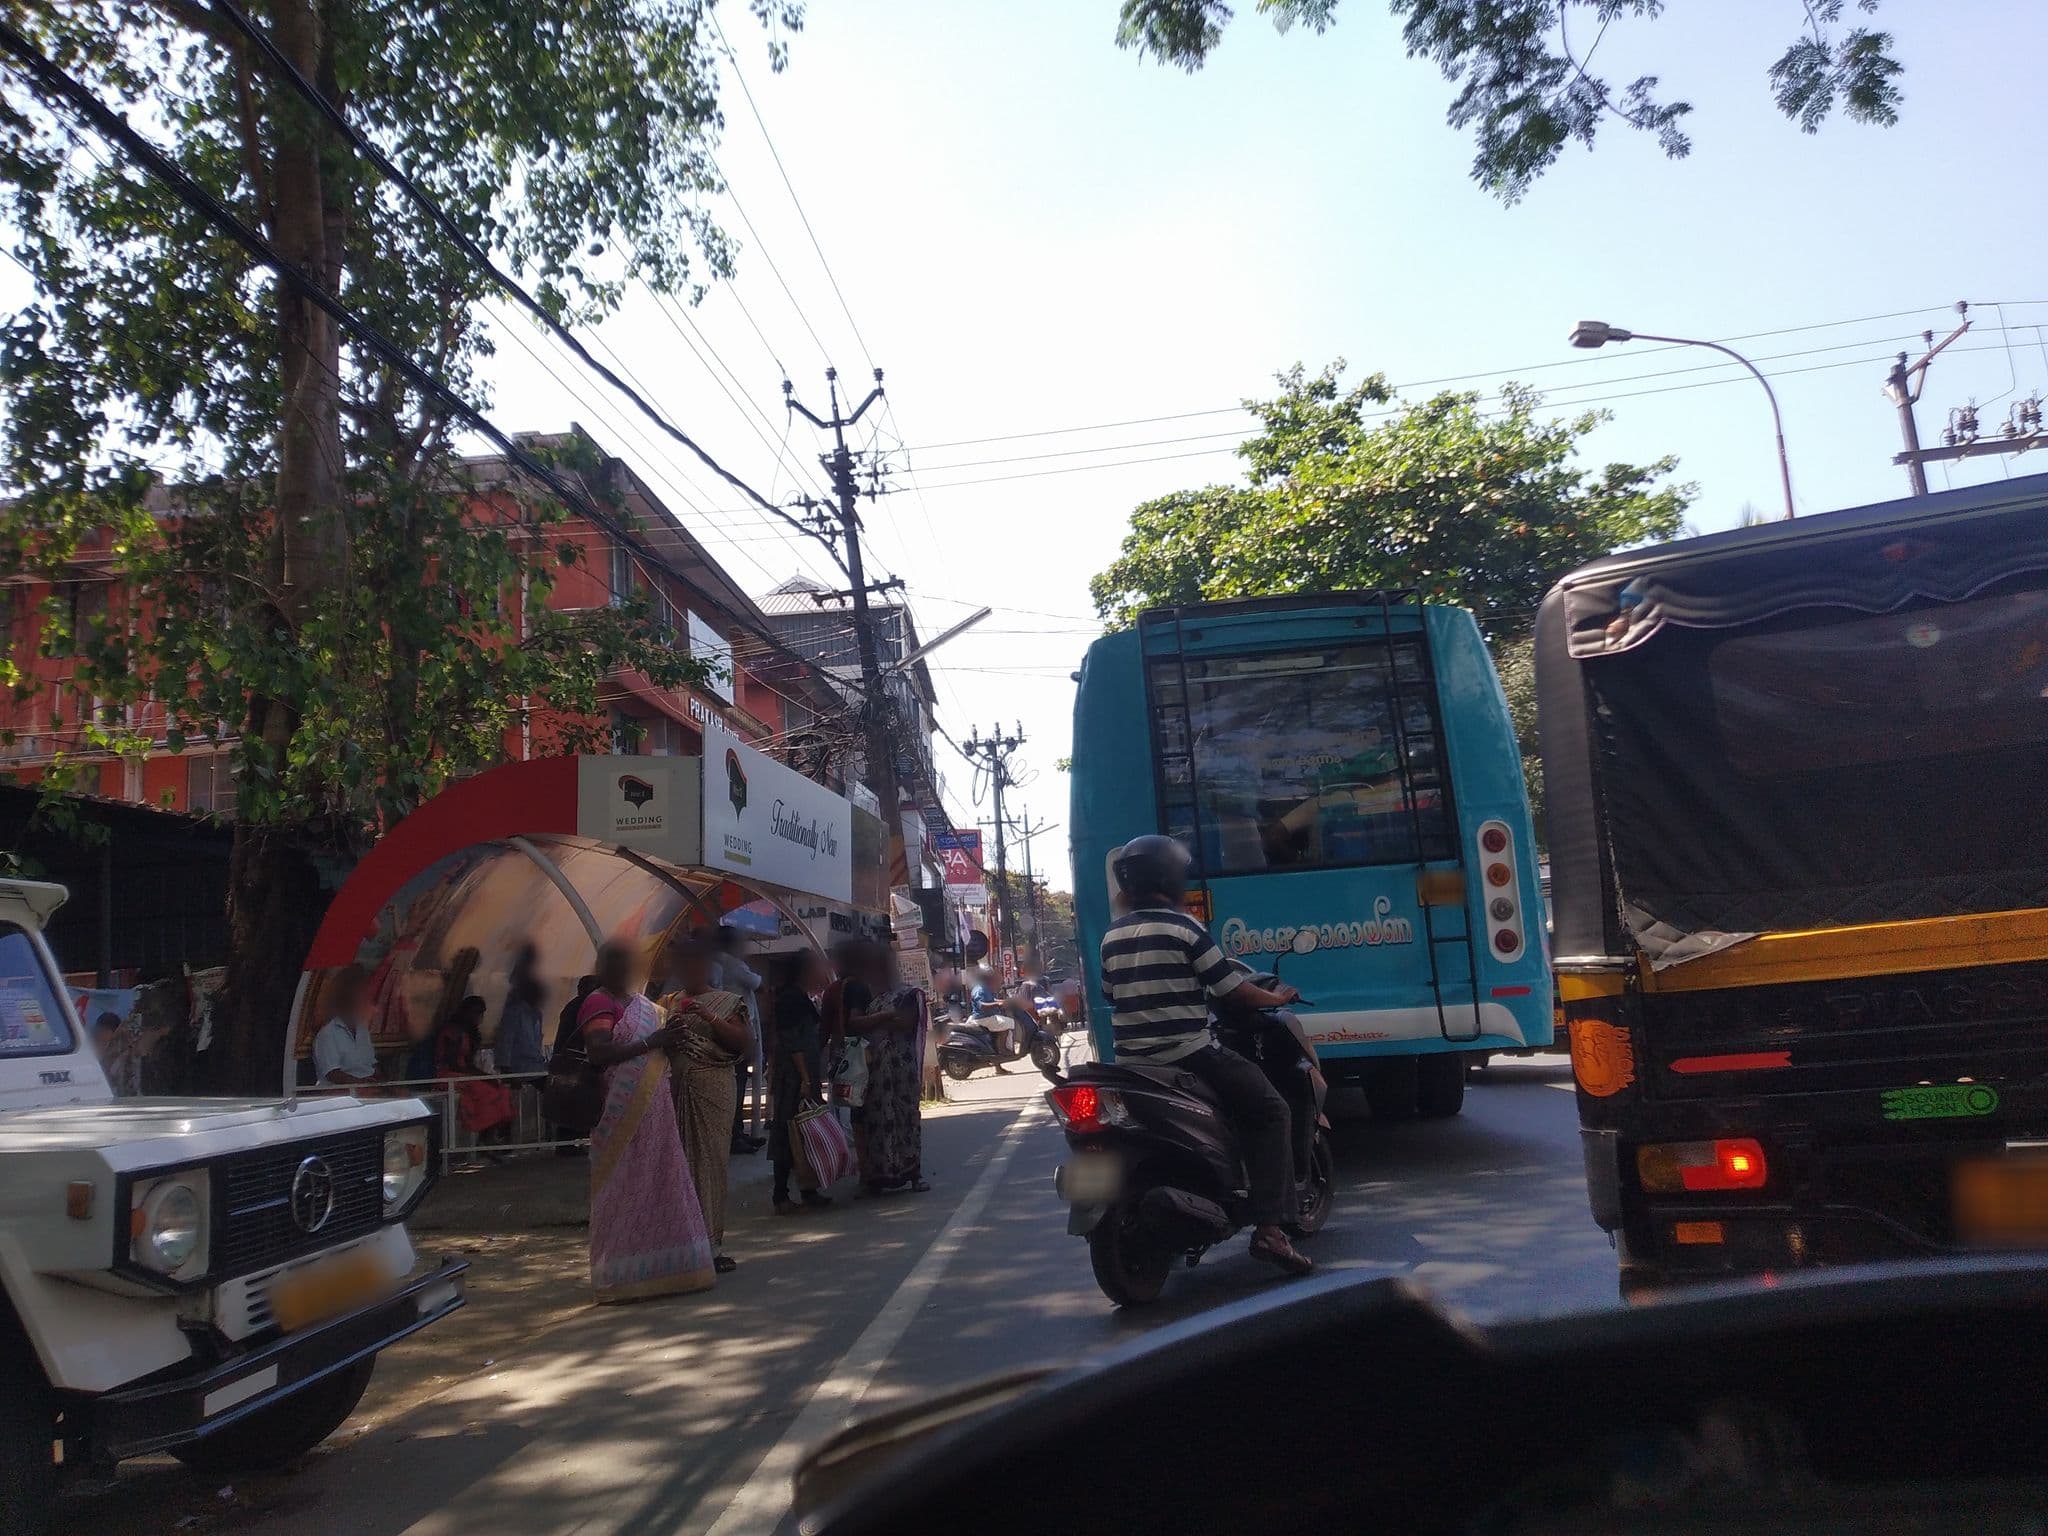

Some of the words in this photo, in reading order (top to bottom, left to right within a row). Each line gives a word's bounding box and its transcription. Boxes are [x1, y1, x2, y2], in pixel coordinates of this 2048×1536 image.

[616, 815, 663, 825] WEDDING
[770, 798, 819, 861] Traditionally
[724, 834, 753, 854] WEDDING
[38, 1071, 71, 1084] TRAX
[1905, 1091, 1965, 1105] SOUND
[1909, 1102, 1961, 1115] HORN
